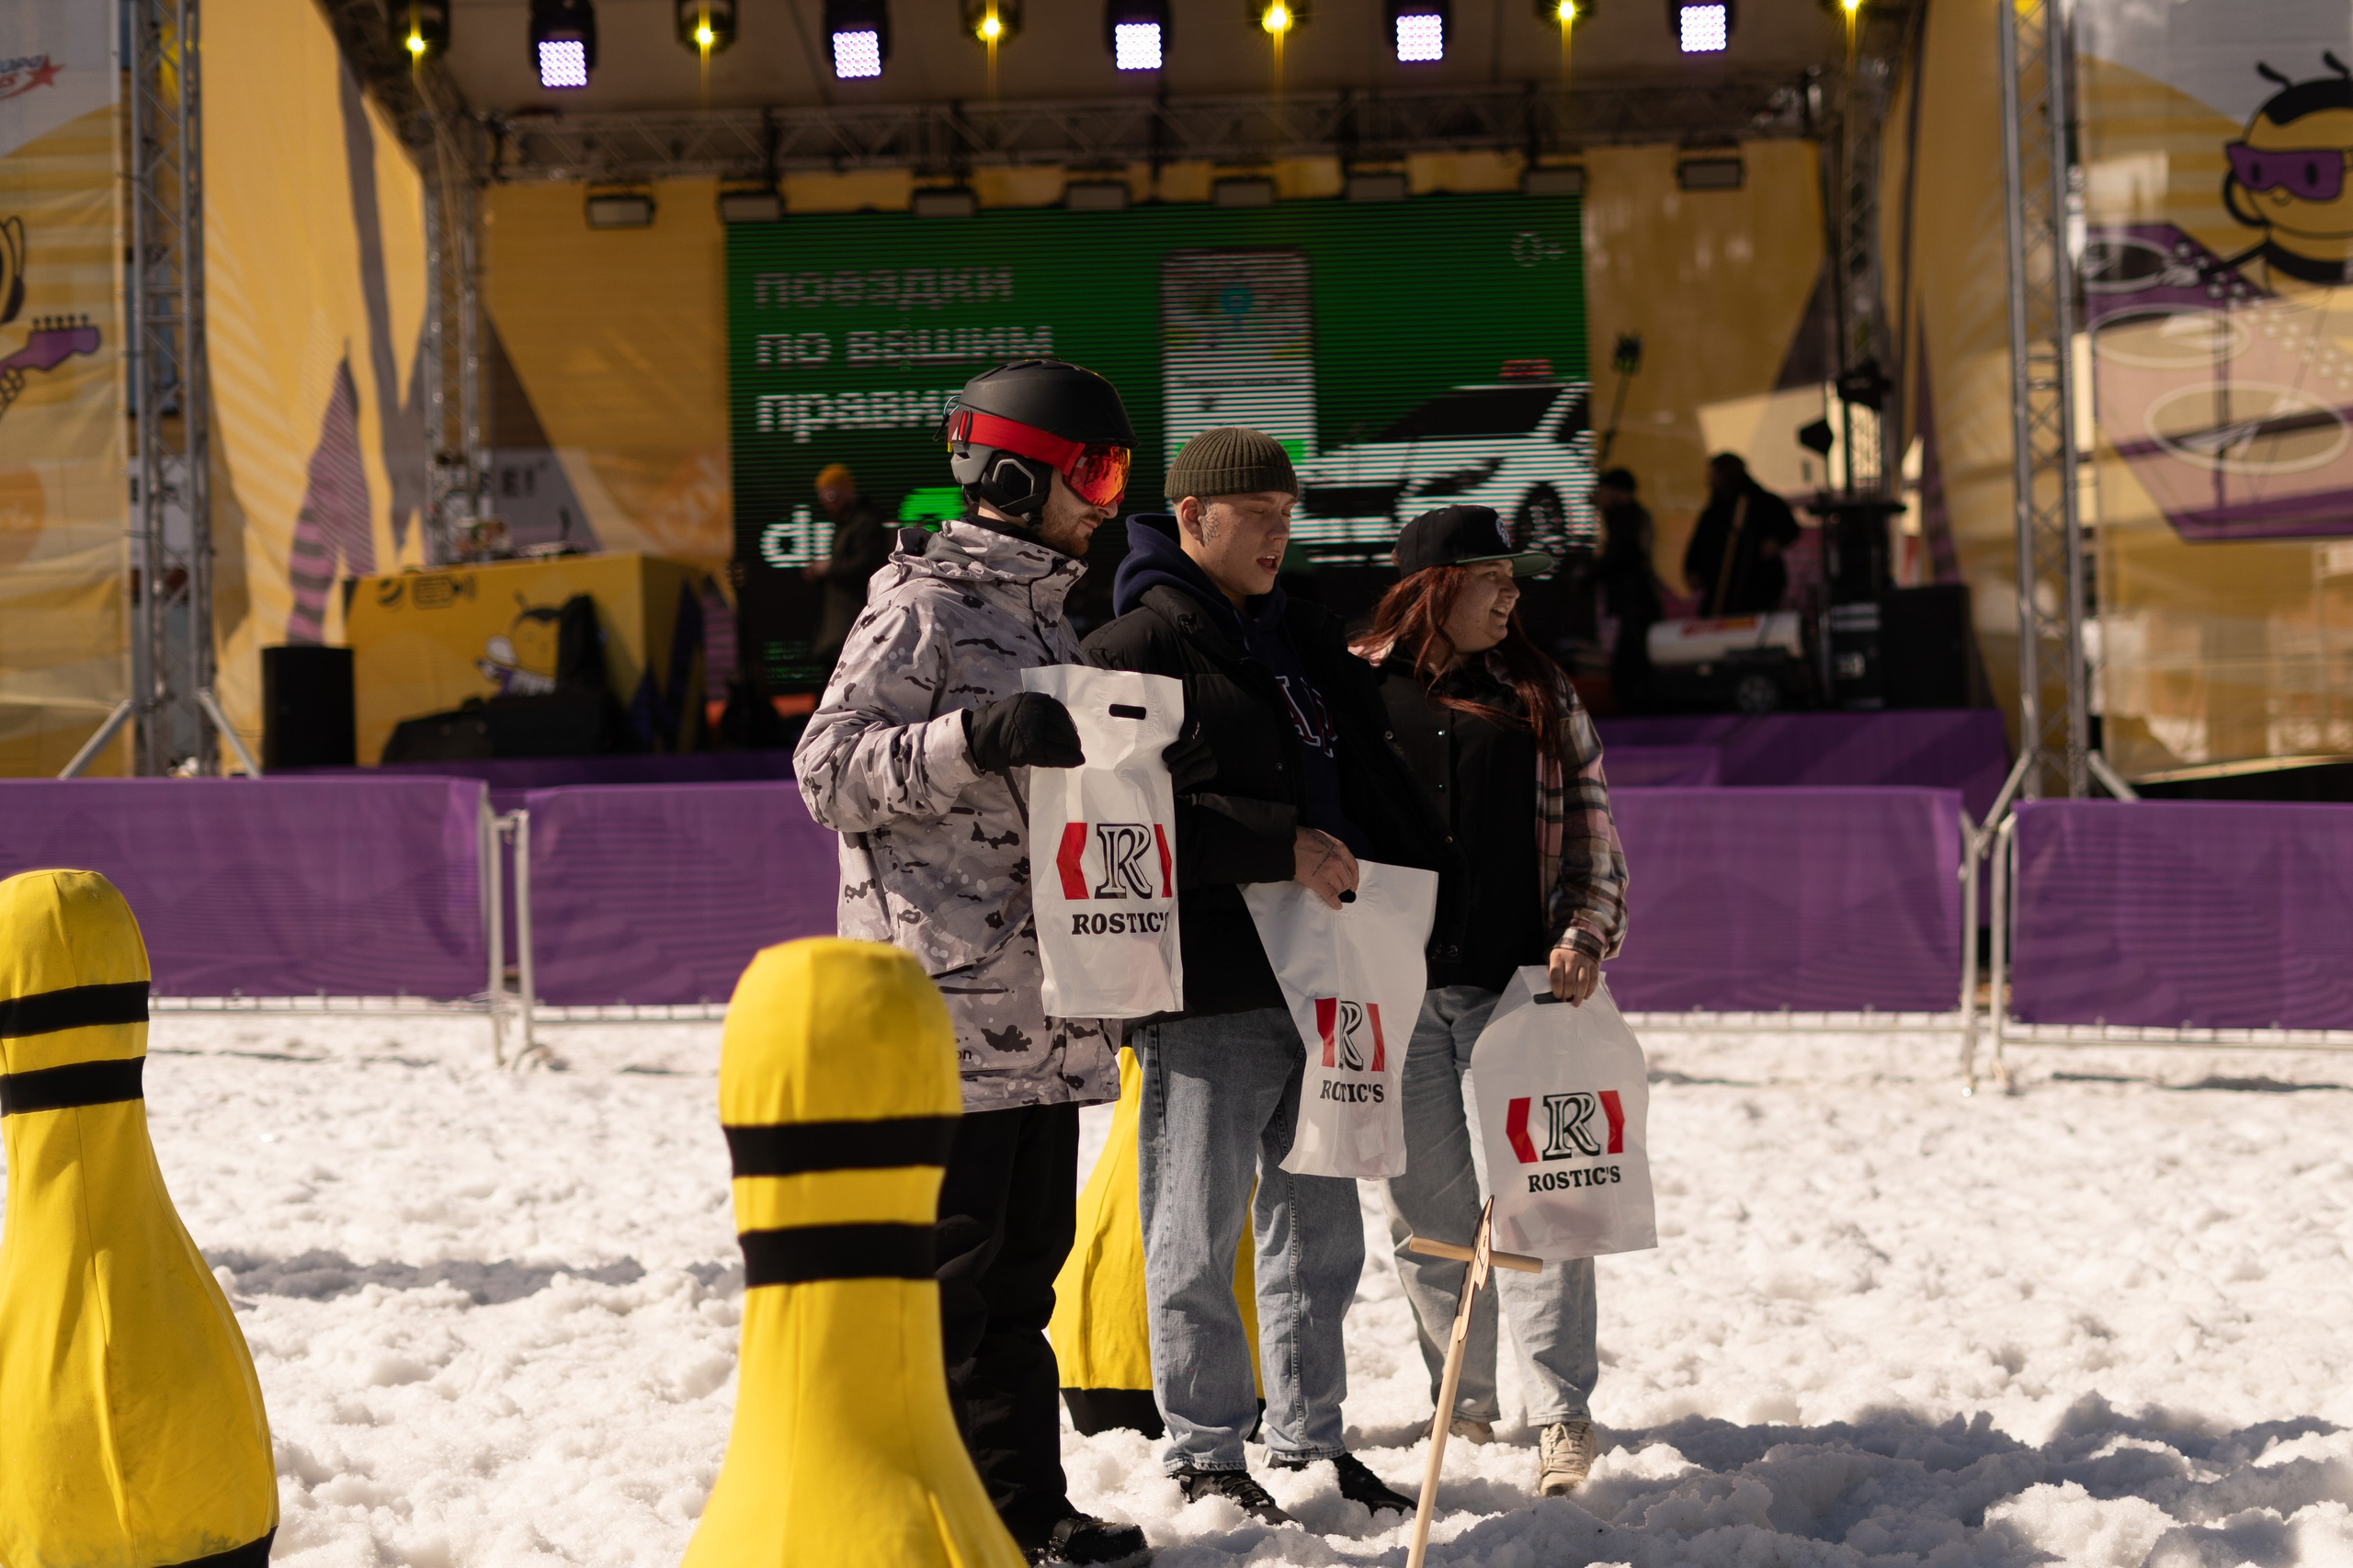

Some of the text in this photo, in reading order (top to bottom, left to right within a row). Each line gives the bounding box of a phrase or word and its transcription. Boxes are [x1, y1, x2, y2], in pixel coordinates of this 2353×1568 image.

[755, 267, 1014, 311] поездки
[756, 325, 1055, 369] по вашим
[1094, 823, 1153, 900] R
[1320, 1079, 1385, 1104] ROTIC'S
[1541, 1092, 1601, 1162] R
[1528, 1165, 1621, 1193] ROSTIC'S
